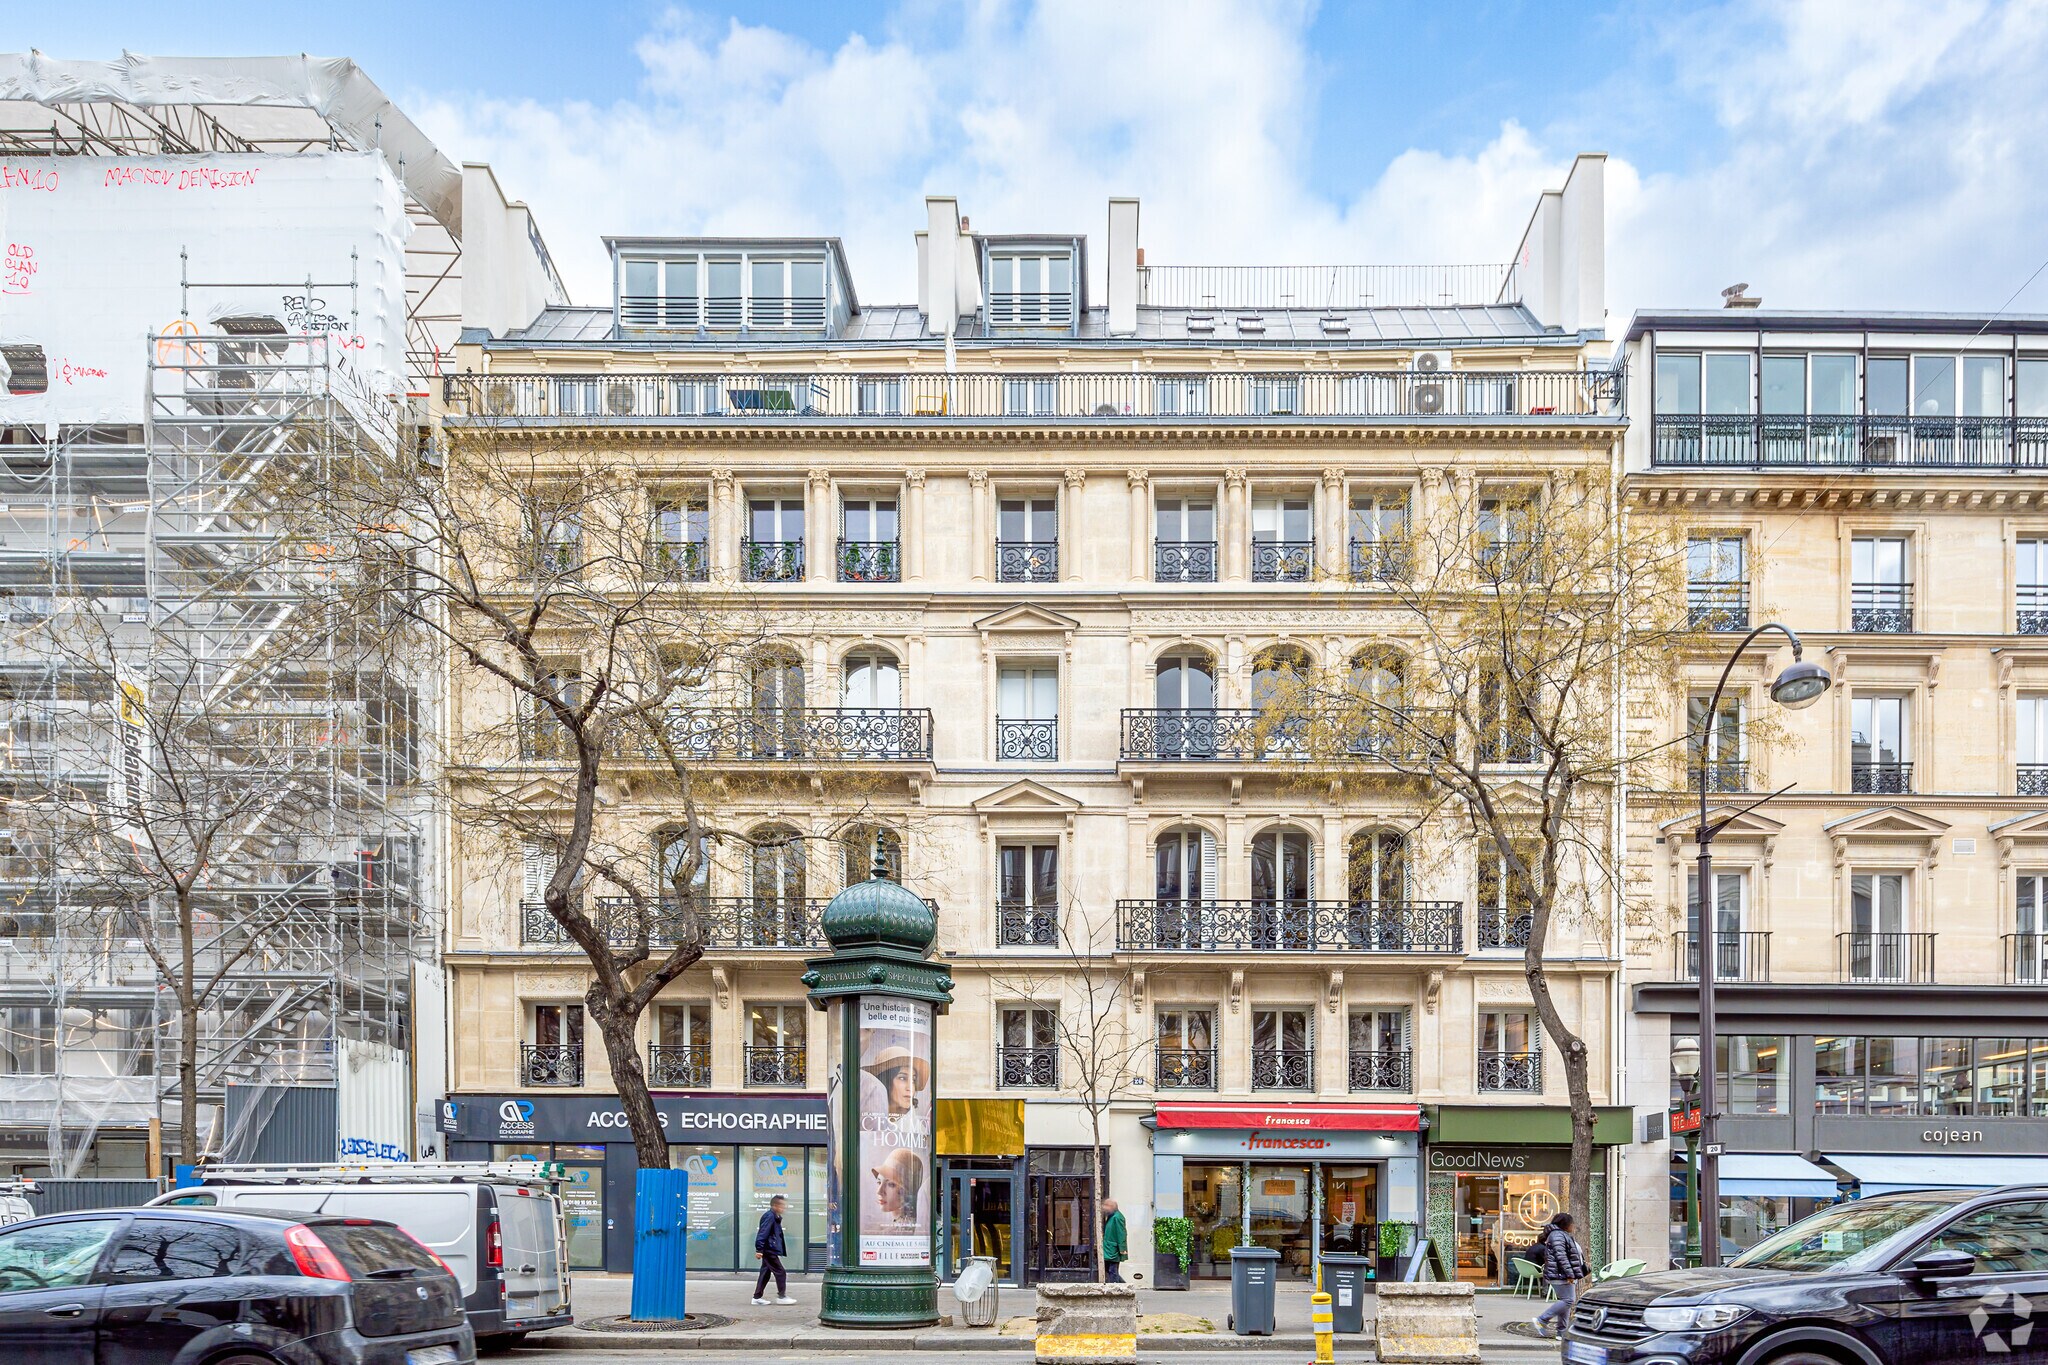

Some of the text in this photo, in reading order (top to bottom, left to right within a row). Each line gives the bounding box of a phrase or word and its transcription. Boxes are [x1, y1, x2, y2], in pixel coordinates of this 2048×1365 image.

[104, 167, 260, 191] MACRON DEMISION
[8, 243, 34, 259] OLD
[821, 971, 936, 986] SPECTACLES SPECTACLES
[882, 1003, 911, 1013] histoire
[868, 1012, 887, 1021] belle
[889, 1013, 898, 1021] et
[499, 1121, 535, 1130] ACCESS
[586, 1110, 828, 1130] ACCS ECHOGRAPHIE
[861, 1116, 904, 1132] C'EST
[1673, 1111, 1701, 1131] MERO
[873, 1131, 928, 1149] HOMME
[1923, 1126, 1983, 1146] cojean
[1710, 1145, 1719, 1153] 20
[1430, 1151, 1525, 1168] GoodNews
